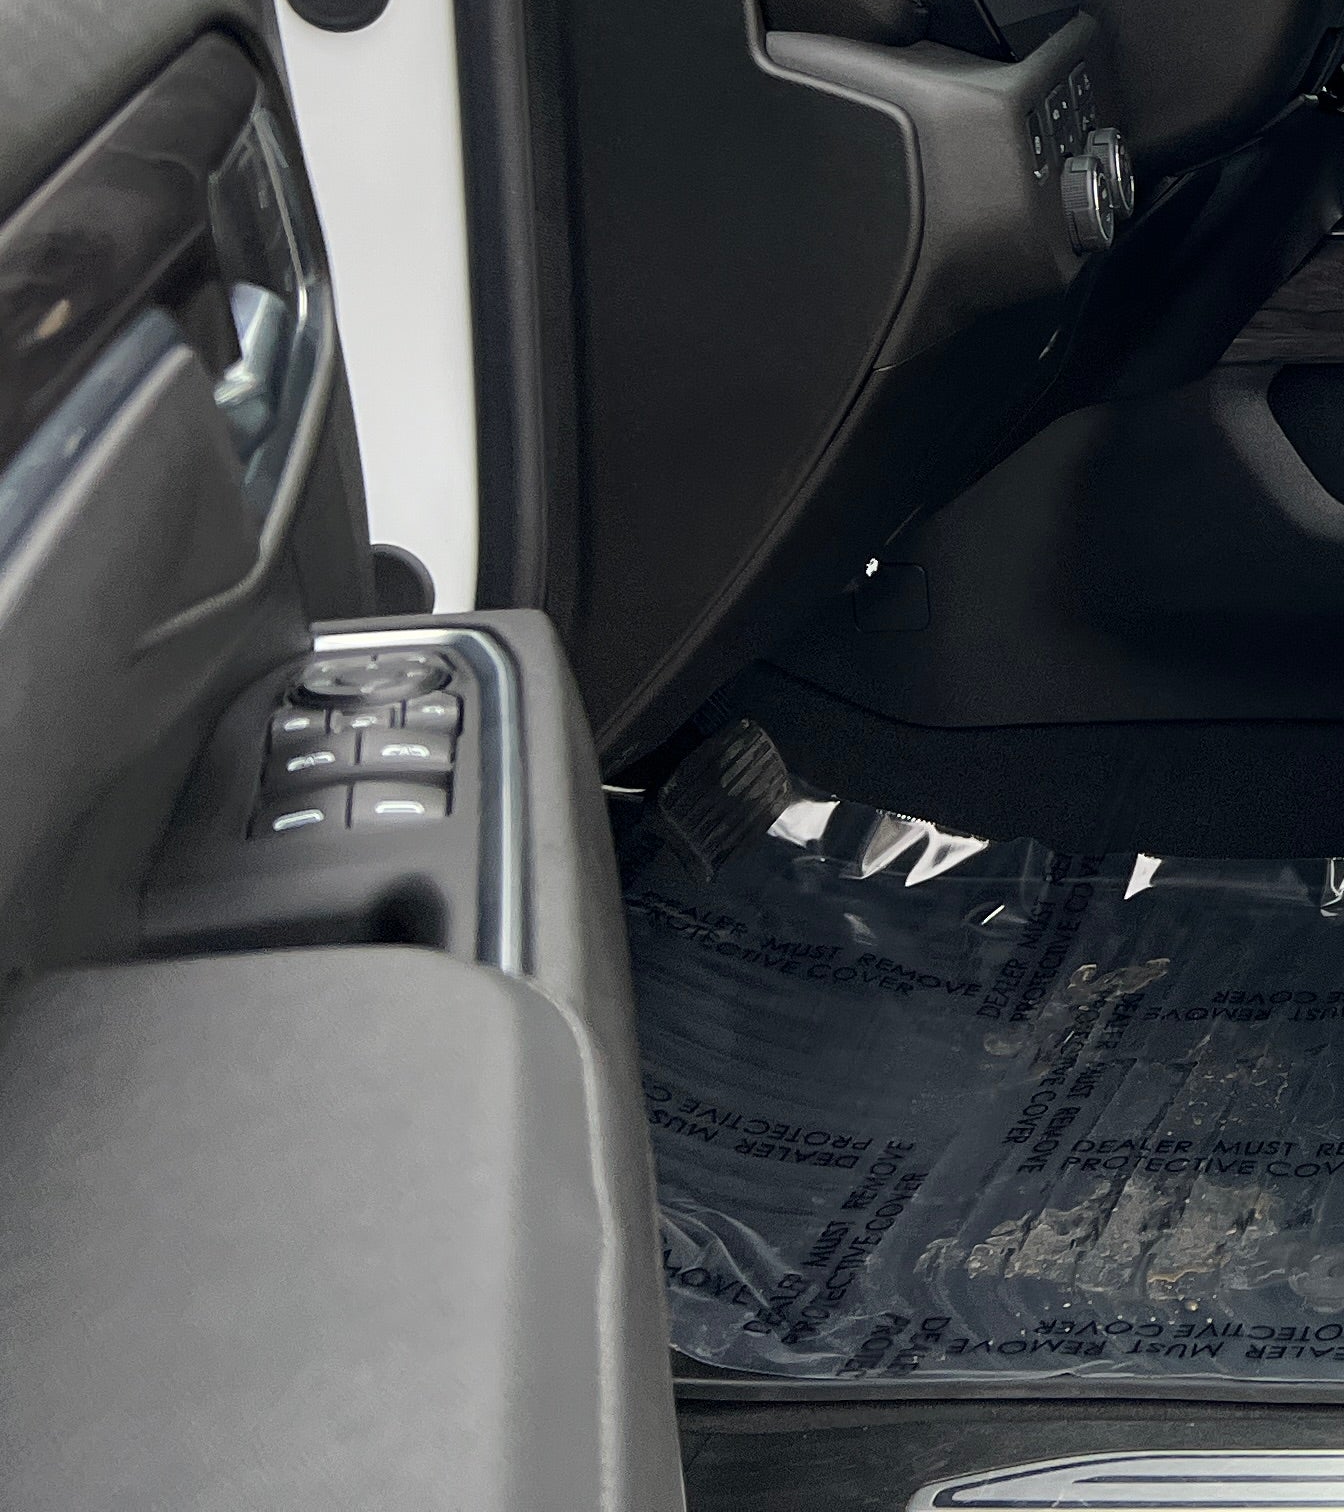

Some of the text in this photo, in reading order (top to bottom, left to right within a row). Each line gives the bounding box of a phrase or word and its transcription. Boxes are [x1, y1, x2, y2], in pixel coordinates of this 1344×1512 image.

[808, 963, 915, 996] COVER
[857, 952, 983, 997] REMOVE
[678, 1097, 873, 1152] PROTECTIVE
[648, 1109, 860, 1170] DEALER MUS
[1071, 1139, 1193, 1156] DEALER
[1212, 1139, 1300, 1157] MUST
[1060, 1155, 1256, 1176] PROTECTIVE
[1035, 1319, 1166, 1338] COVER
[948, 1337, 1101, 1357] REMOVE
[1127, 1341, 1224, 1360] MUST
